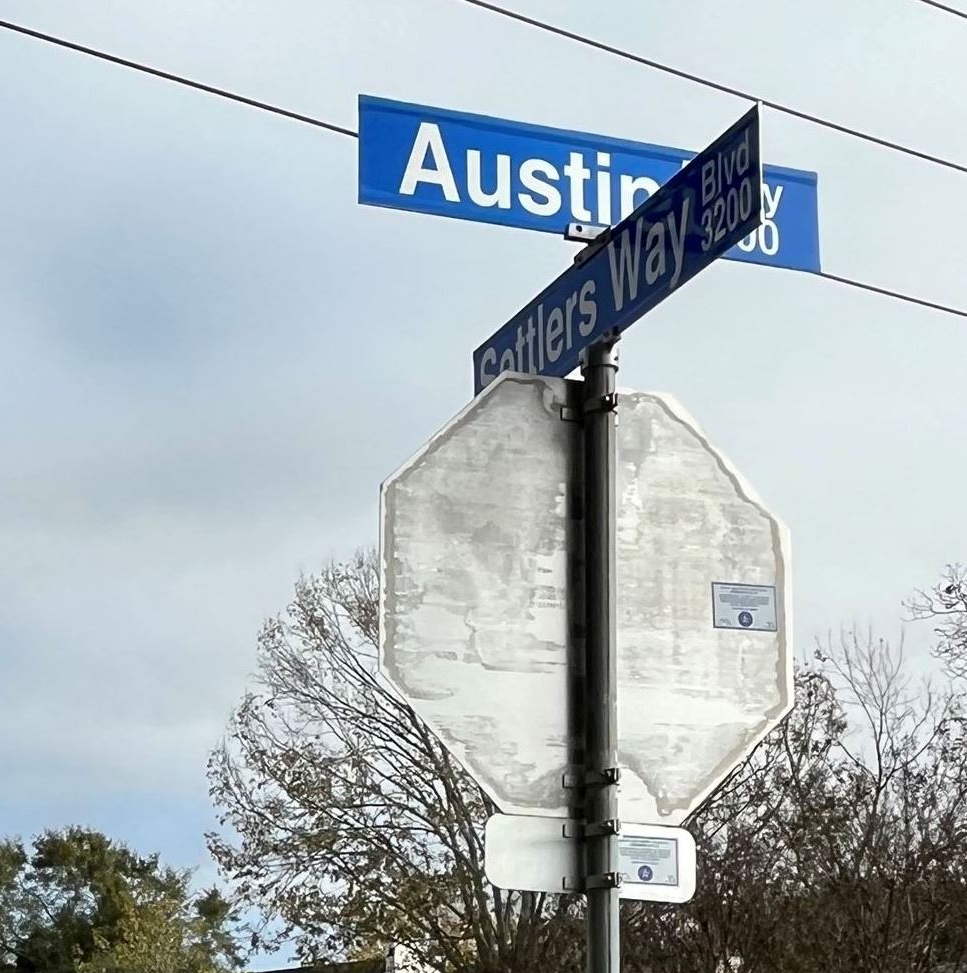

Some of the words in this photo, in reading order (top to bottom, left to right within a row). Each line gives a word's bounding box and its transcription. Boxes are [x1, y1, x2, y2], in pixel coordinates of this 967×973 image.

[399, 121, 659, 225] Austin
[701, 129, 749, 207] Blvd
[606, 196, 690, 311] Way
[701, 177, 752, 251] 3200
